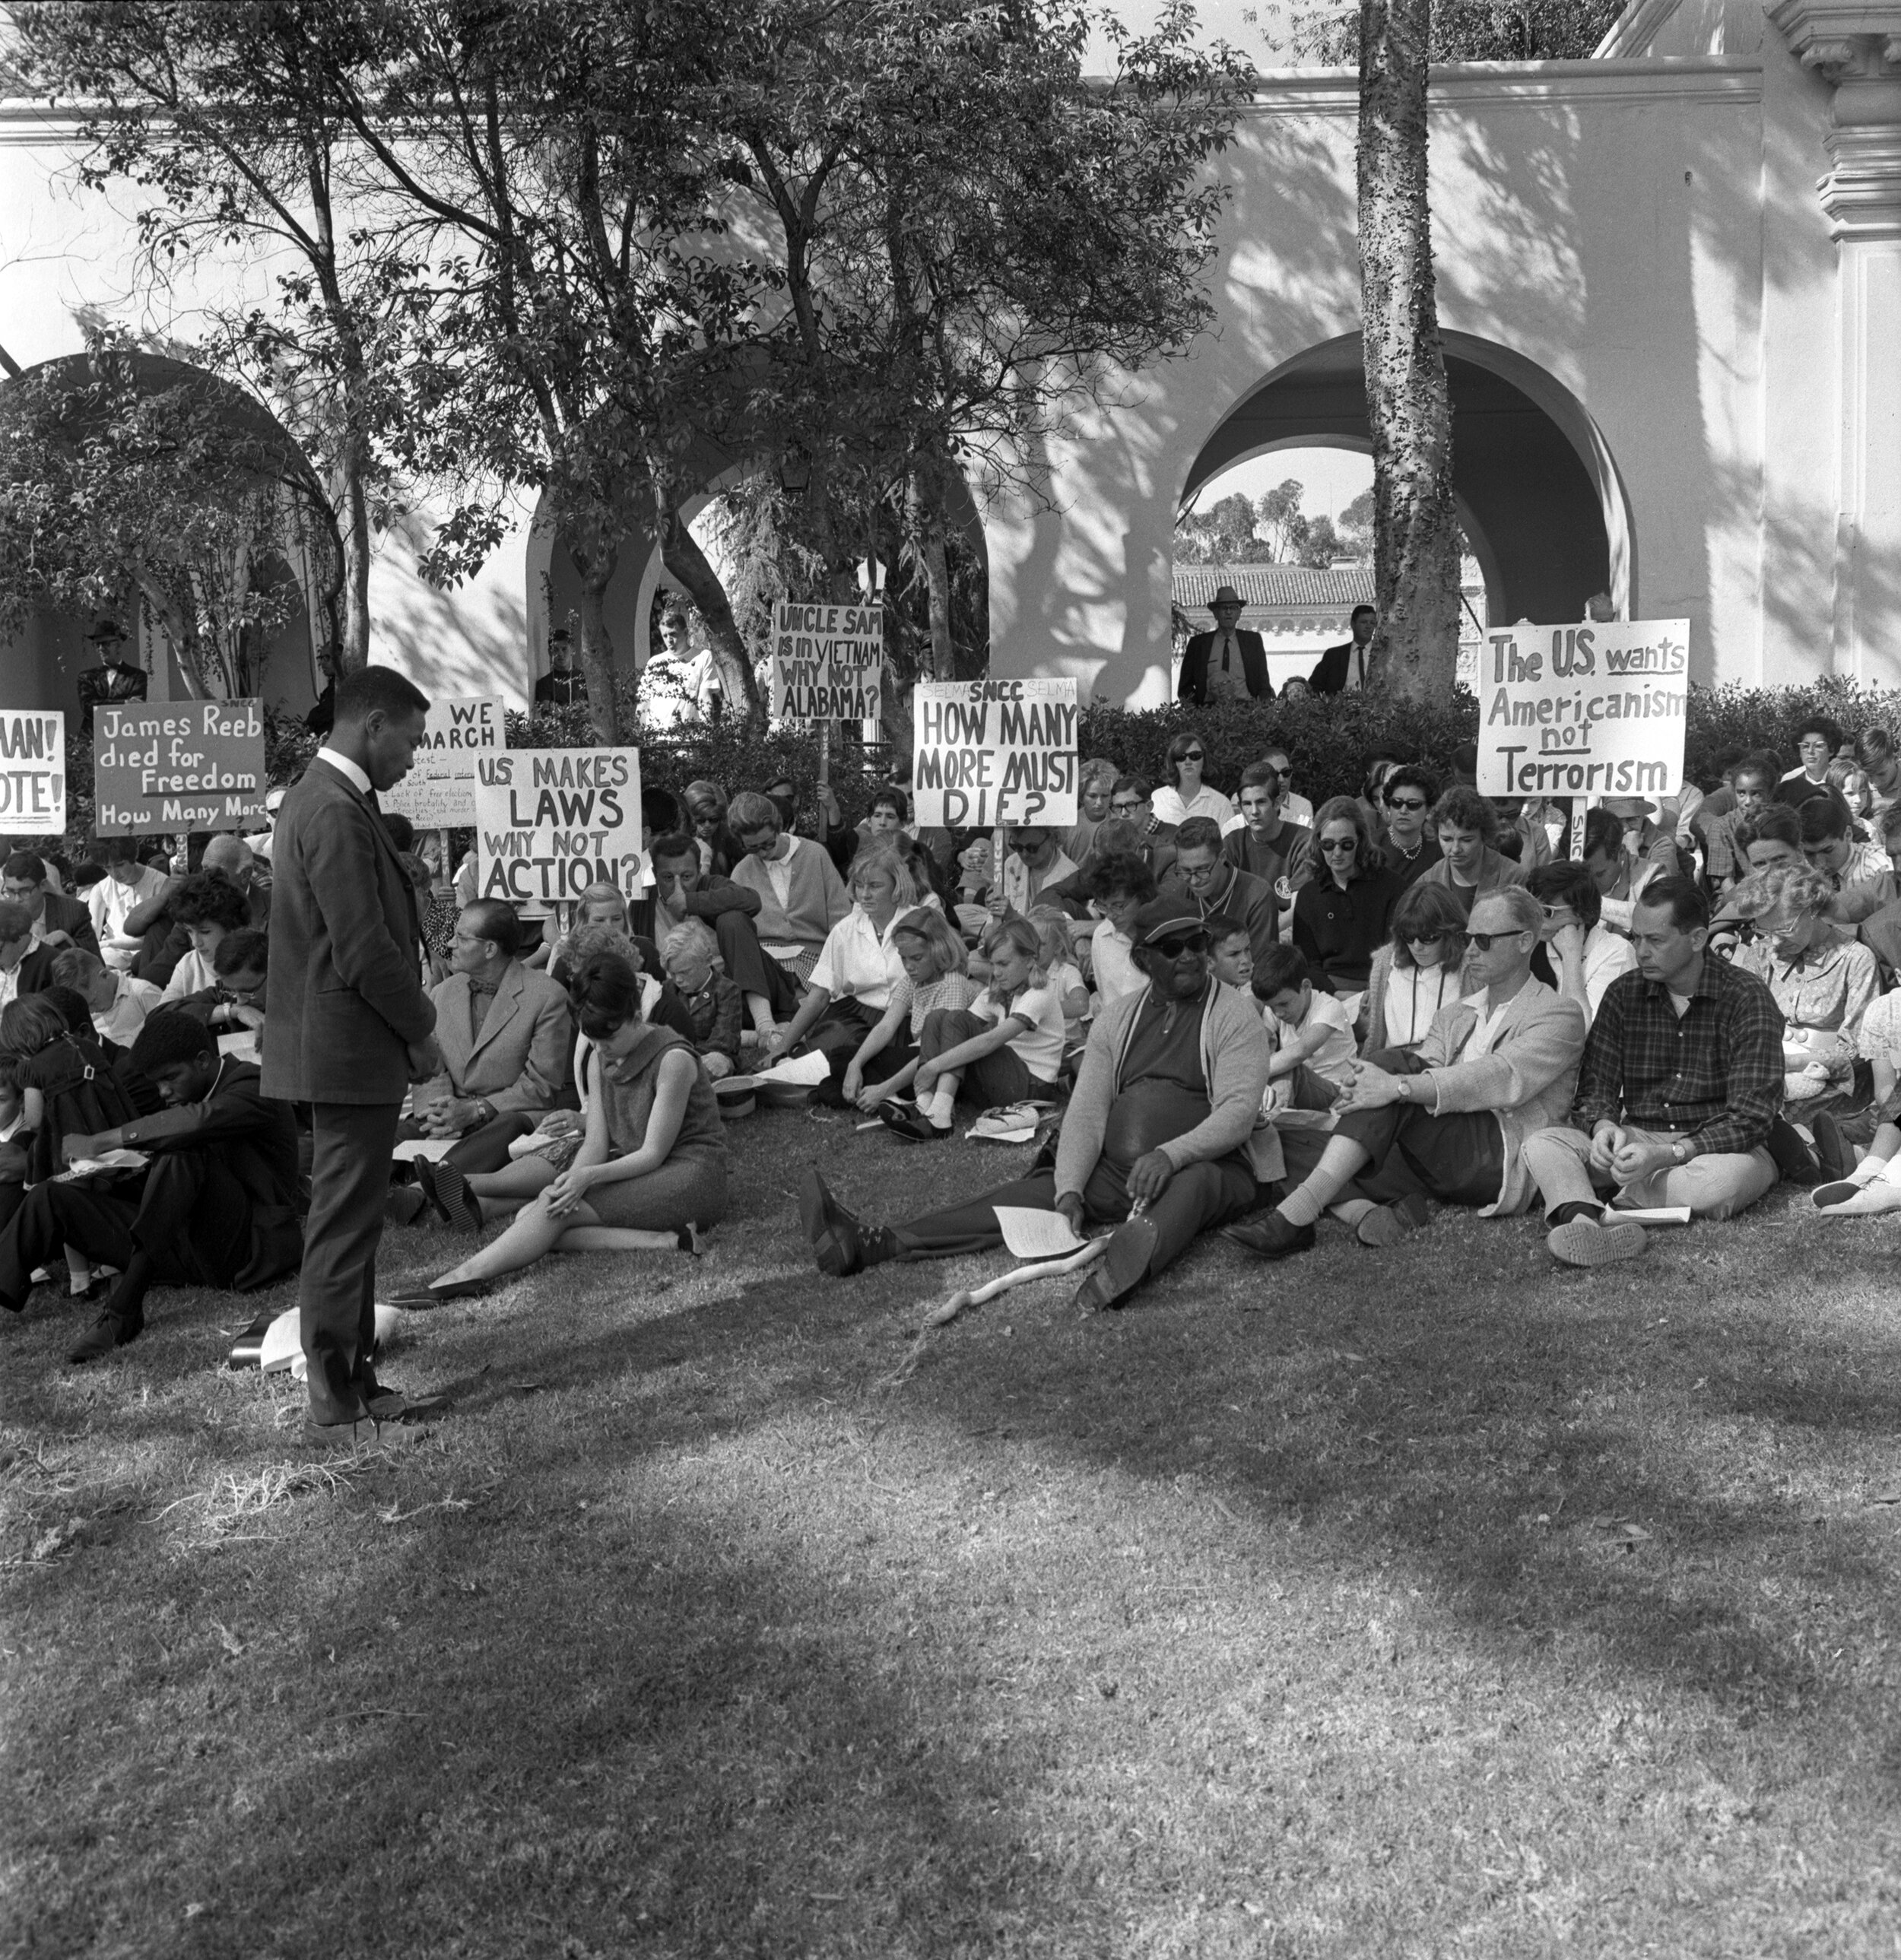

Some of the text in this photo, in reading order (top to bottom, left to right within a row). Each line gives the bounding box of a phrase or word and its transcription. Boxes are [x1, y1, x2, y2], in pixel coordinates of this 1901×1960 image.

[780, 605, 882, 636] UNCLE SAM
[777, 636, 793, 657] IS
[815, 639, 881, 668] VIETNAM
[1489, 629, 1685, 683] The U.S. wants
[779, 660, 868, 688] WHY NOT
[221, 699, 255, 709] SNCC
[782, 685, 879, 718] ALABAMA?
[921, 680, 1075, 702] SELMA SNCC SELMA
[1487, 683, 1687, 726] Americanism
[103, 705, 262, 739] James Reeb
[450, 702, 493, 725] WE
[924, 701, 1077, 747] HOW MANY
[1541, 718, 1593, 750] not
[100, 738, 205, 768] died for
[1496, 746, 1668, 792] Terrorism
[141, 763, 256, 793] Freedom
[534, 755, 629, 789] MAKES
[917, 747, 1078, 794] MORE MUST
[391, 788, 411, 798] Lack
[414, 788, 423, 797] of
[393, 798, 411, 807] Police
[414, 798, 448, 808] brutality
[510, 789, 624, 828] LAWS
[943, 788, 1046, 826] DIE?
[101, 804, 151, 826] How
[162, 799, 219, 826] Many
[484, 830, 609, 858] WHY NOT
[484, 854, 641, 899] ACTION?
[994, 839, 1002, 882] SNCC
